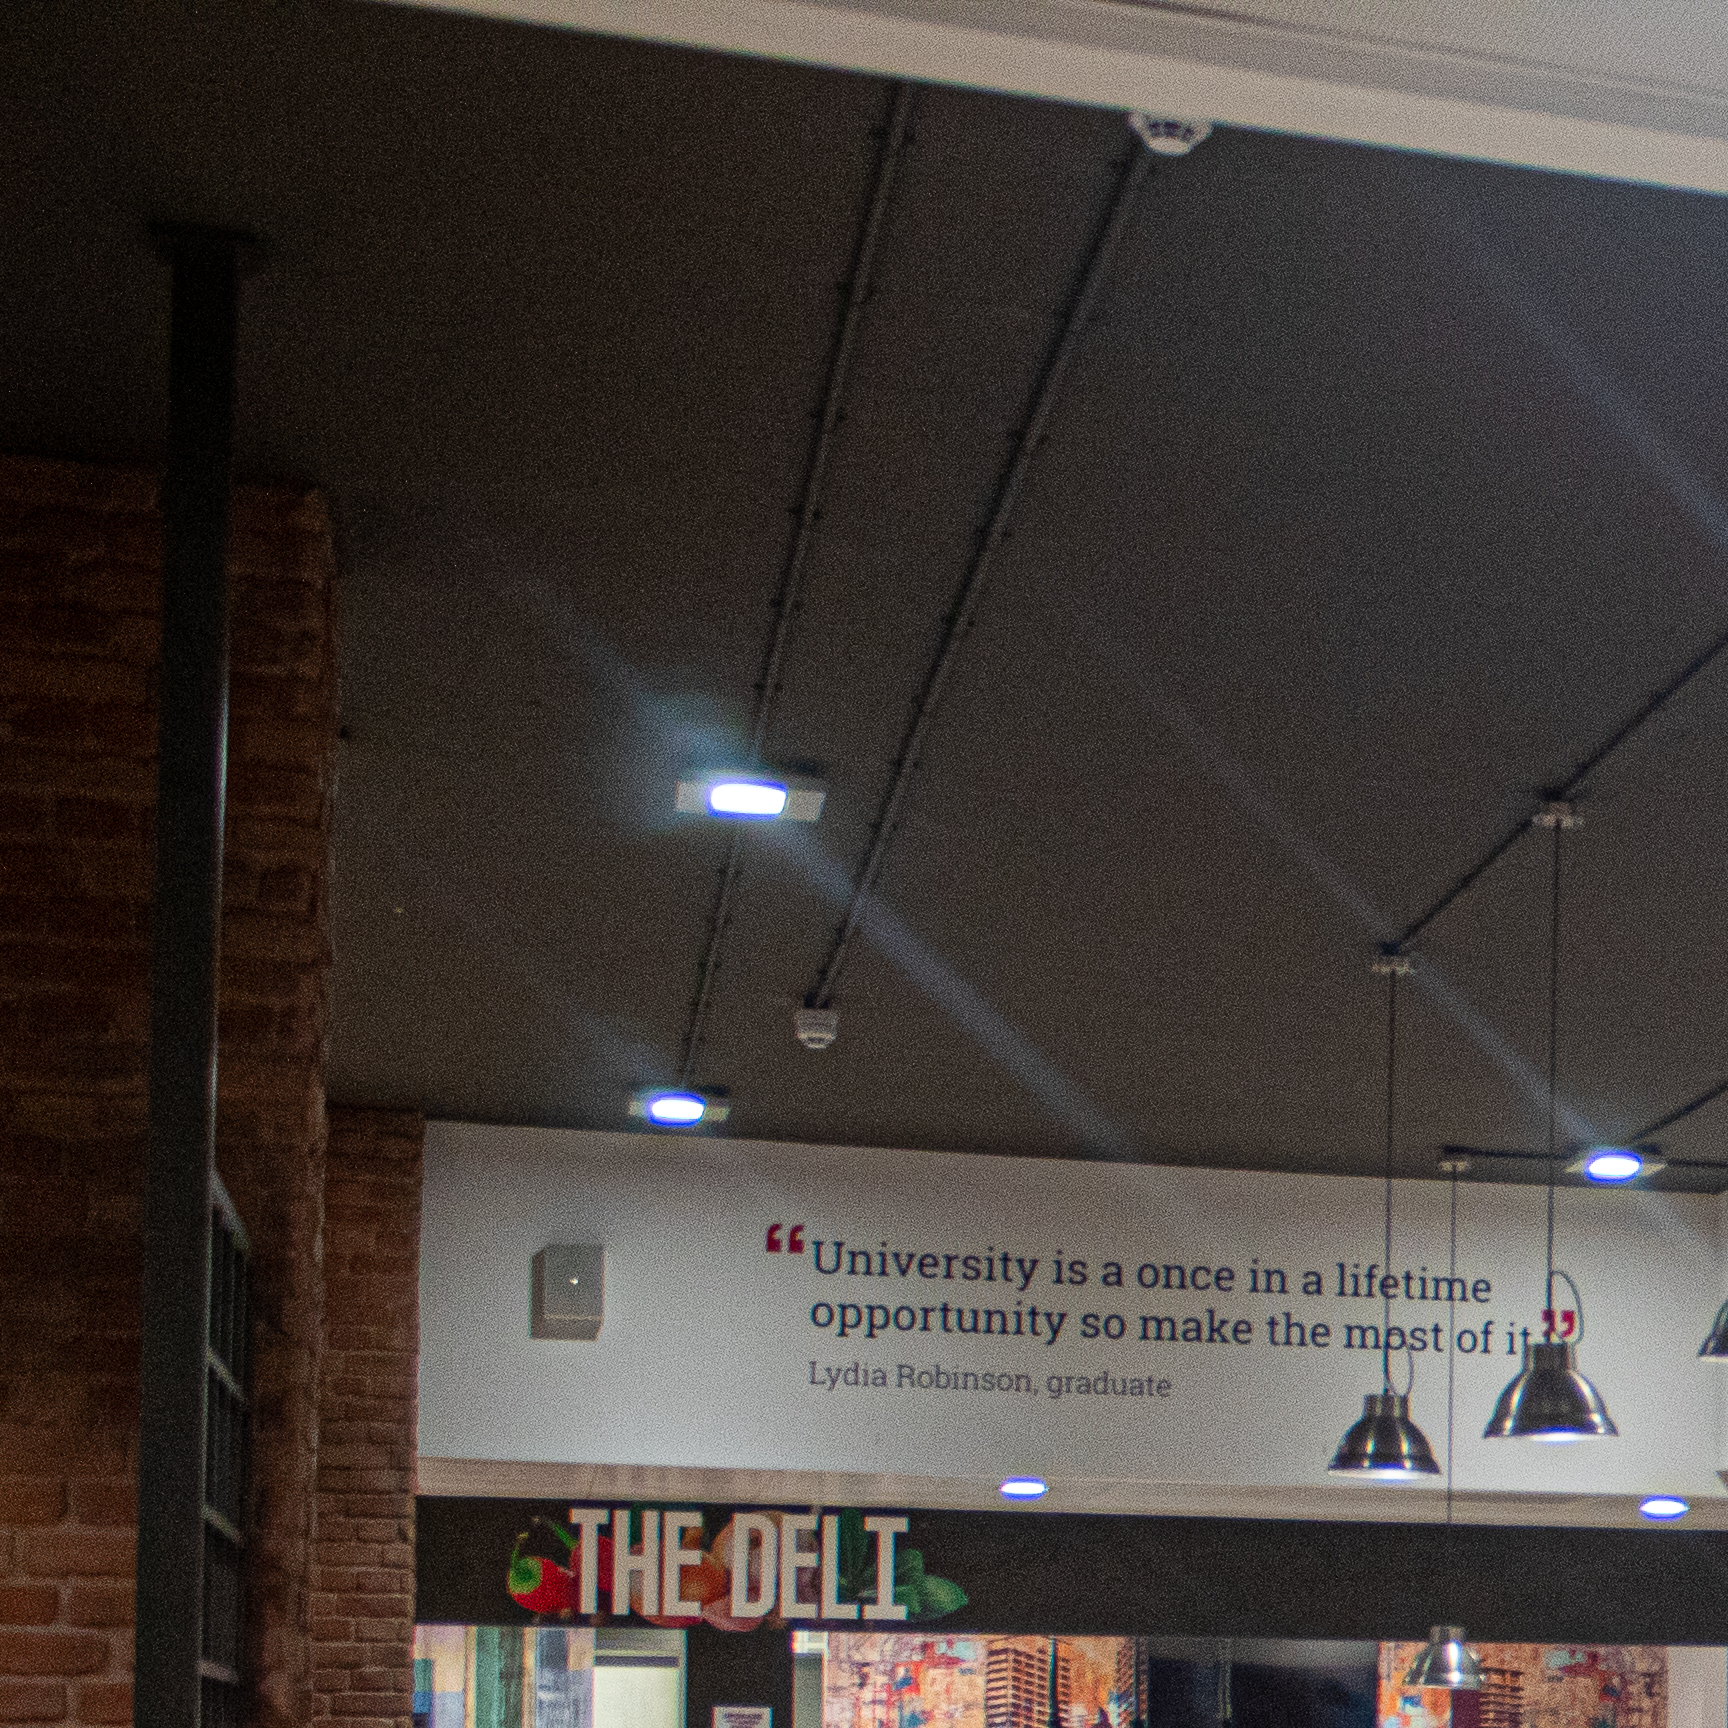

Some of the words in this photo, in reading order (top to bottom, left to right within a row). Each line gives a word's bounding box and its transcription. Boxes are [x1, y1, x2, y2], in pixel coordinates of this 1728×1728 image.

[1052, 1249, 1089, 1286] is
[1101, 1260, 1124, 1288] a
[1136, 1262, 1235, 1292] once
[1249, 1259, 1289, 1295] in
[1300, 1268, 1325, 1297] a
[1335, 1262, 1492, 1303] lifetime
[809, 1301, 1068, 1346] opportunity
[1079, 1312, 1127, 1340] so
[1139, 1308, 1253, 1345] make
[1267, 1311, 1331, 1347] the
[1343, 1322, 1445, 1353] most
[1455, 1320, 1494, 1354] of
[808, 1360, 888, 1390] Lydia
[896, 1363, 1039, 1397] Robinson,
[1045, 1370, 1172, 1399] graduate
[569, 1508, 702, 1616] THE
[731, 1511, 910, 1620] DELI
